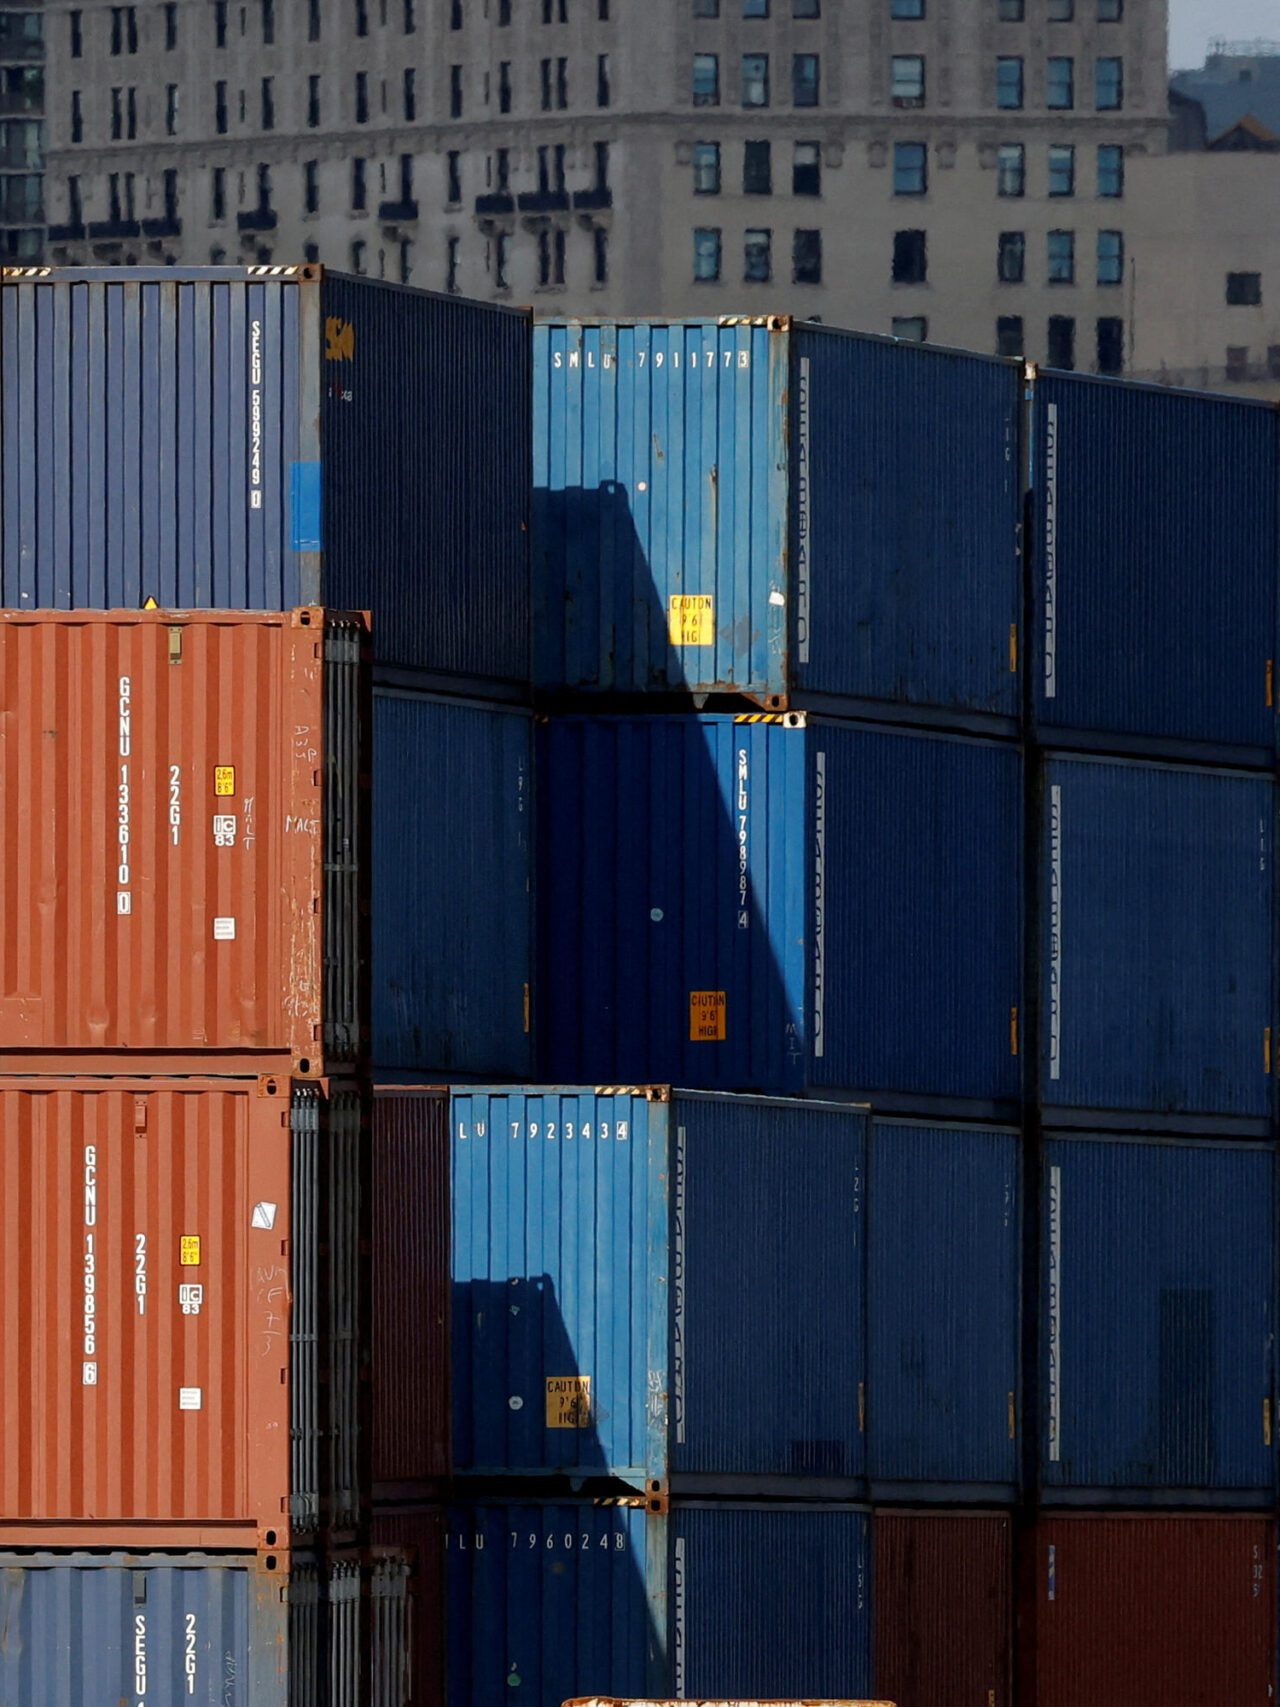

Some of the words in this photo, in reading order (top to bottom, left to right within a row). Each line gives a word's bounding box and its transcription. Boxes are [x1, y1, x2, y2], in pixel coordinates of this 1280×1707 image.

[251, 320, 261, 385] SEGU
[553, 351, 612, 369] SMLU
[638, 350, 749, 369] 7911773
[119, 676, 130, 757] GCNU
[169, 765, 181, 846] 22G1
[738, 749, 748, 811] SMLU
[118, 764, 129, 885] 133610
[215, 834, 235, 847] 83
[738, 815, 748, 906] 798987
[511, 1120, 628, 1140] 7923434
[85, 1145, 96, 1227] GCNU
[84, 1232, 95, 1355] 139856
[135, 1233, 147, 1316] 22G1
[182, 1304, 200, 1315] 83
[511, 1531, 625, 1551] 7960248
[135, 1614, 146, 1695] SEGU
[185, 1613, 197, 1695] 22G1
